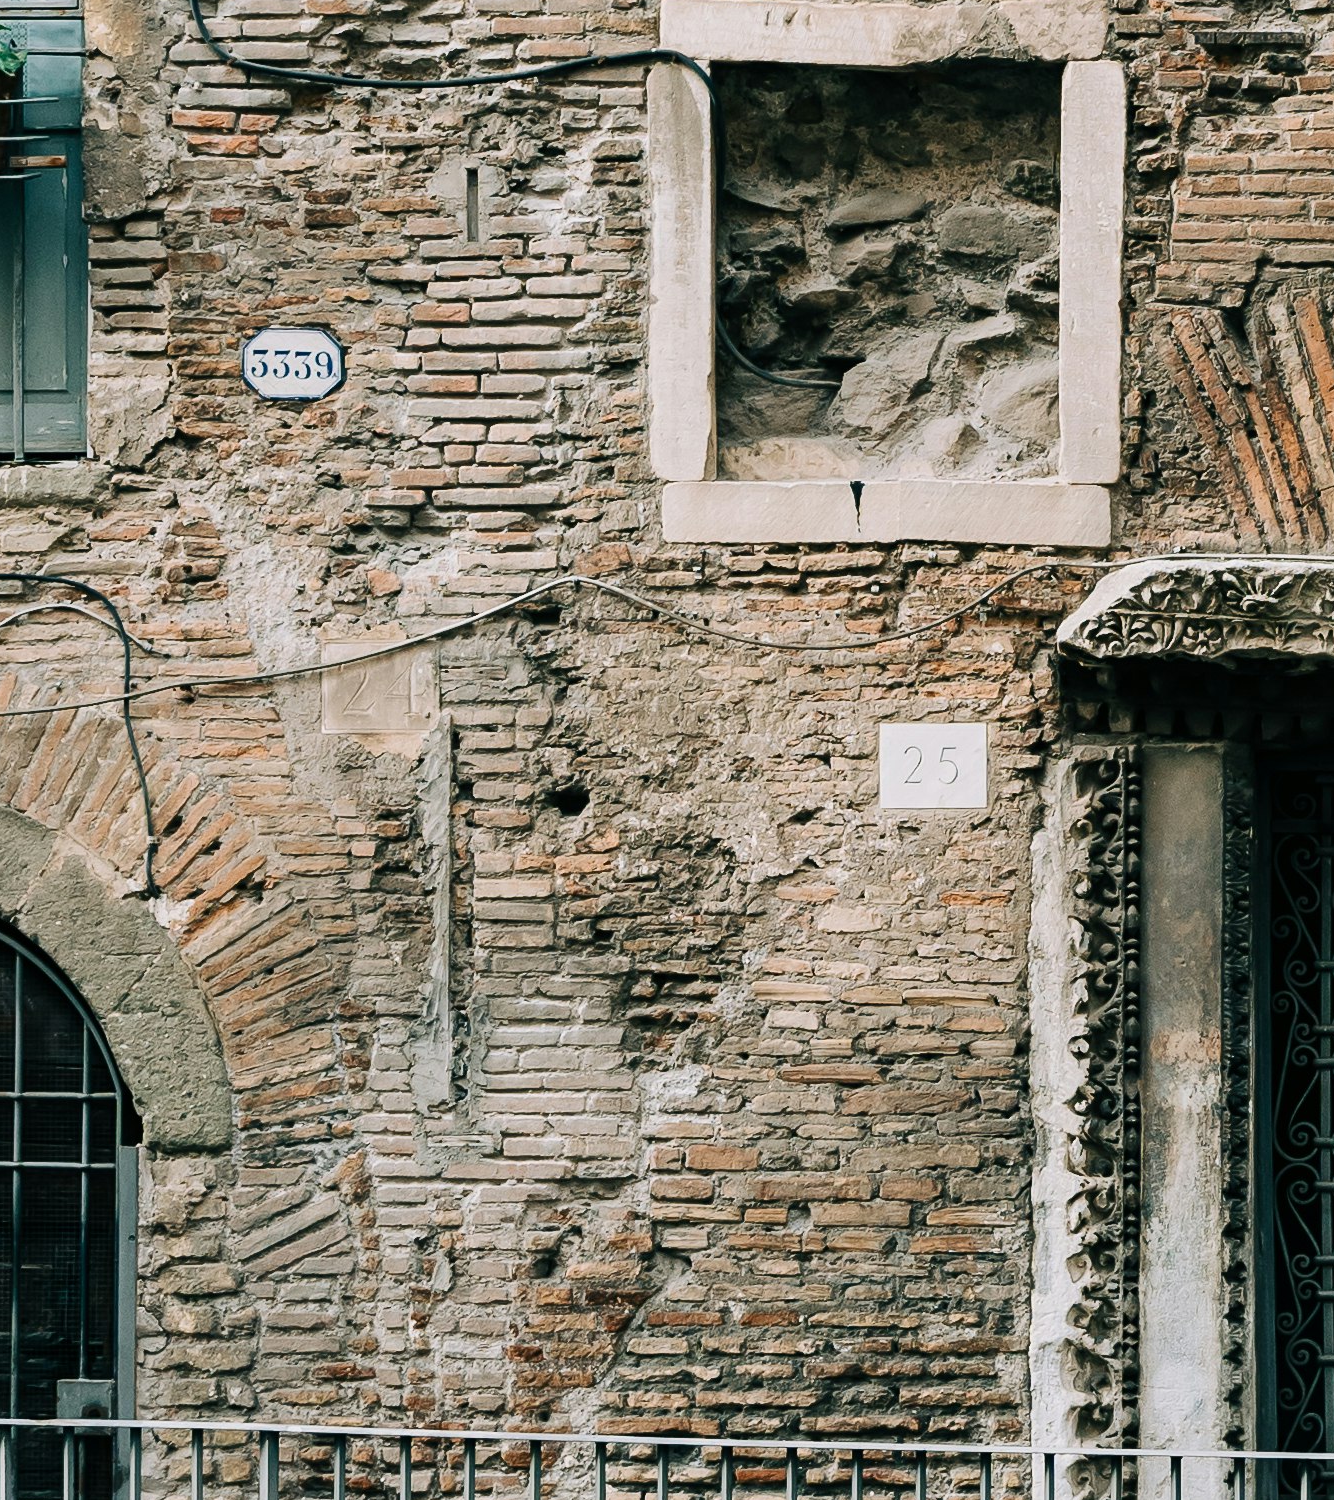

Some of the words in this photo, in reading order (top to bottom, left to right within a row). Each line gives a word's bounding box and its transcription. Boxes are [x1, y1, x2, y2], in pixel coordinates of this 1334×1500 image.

[251, 349, 334, 380] 3339
[338, 661, 427, 717] 24
[903, 745, 959, 785] 25
